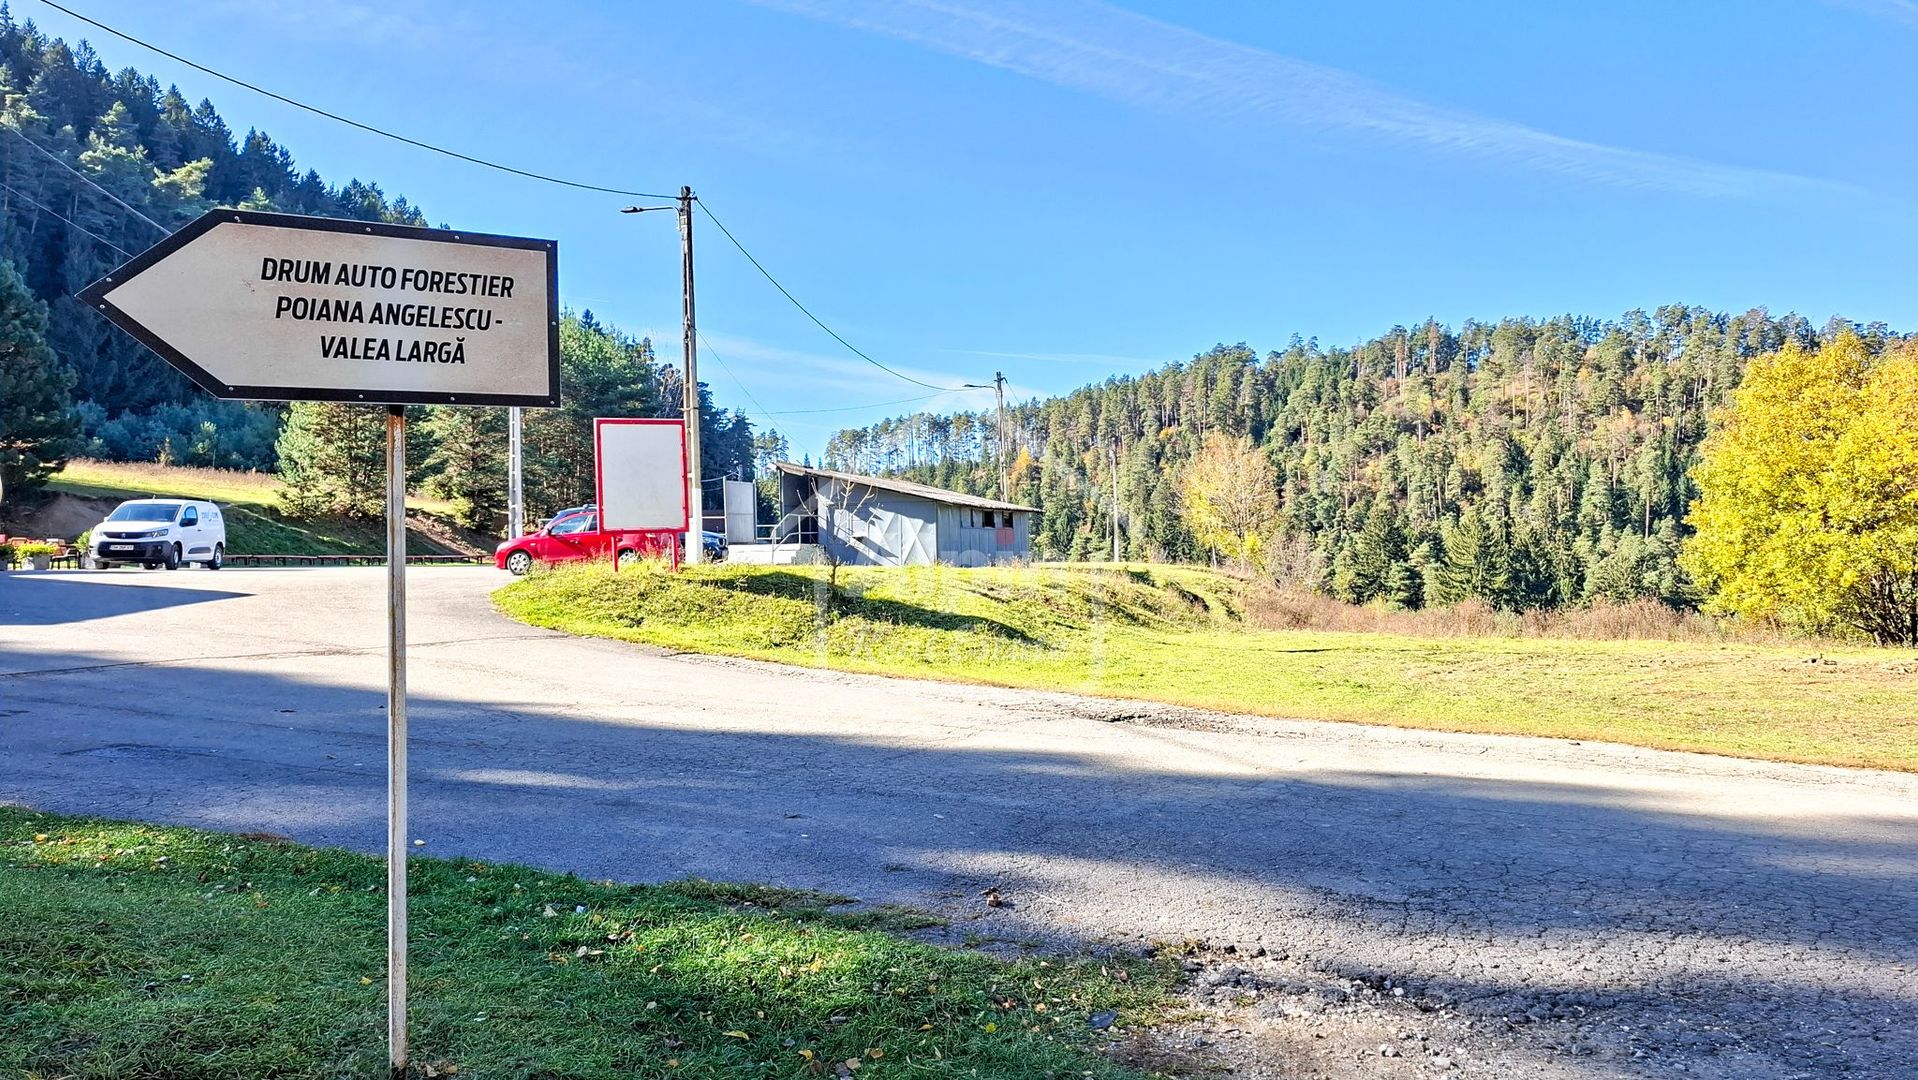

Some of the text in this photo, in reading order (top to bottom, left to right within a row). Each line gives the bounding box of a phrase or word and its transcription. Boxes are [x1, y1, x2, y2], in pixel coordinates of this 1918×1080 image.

[261, 257, 515, 298] DRUM AUTO FORESTIER
[275, 295, 364, 323] POIANA
[320, 335, 466, 364] VALEA LARGĂ
